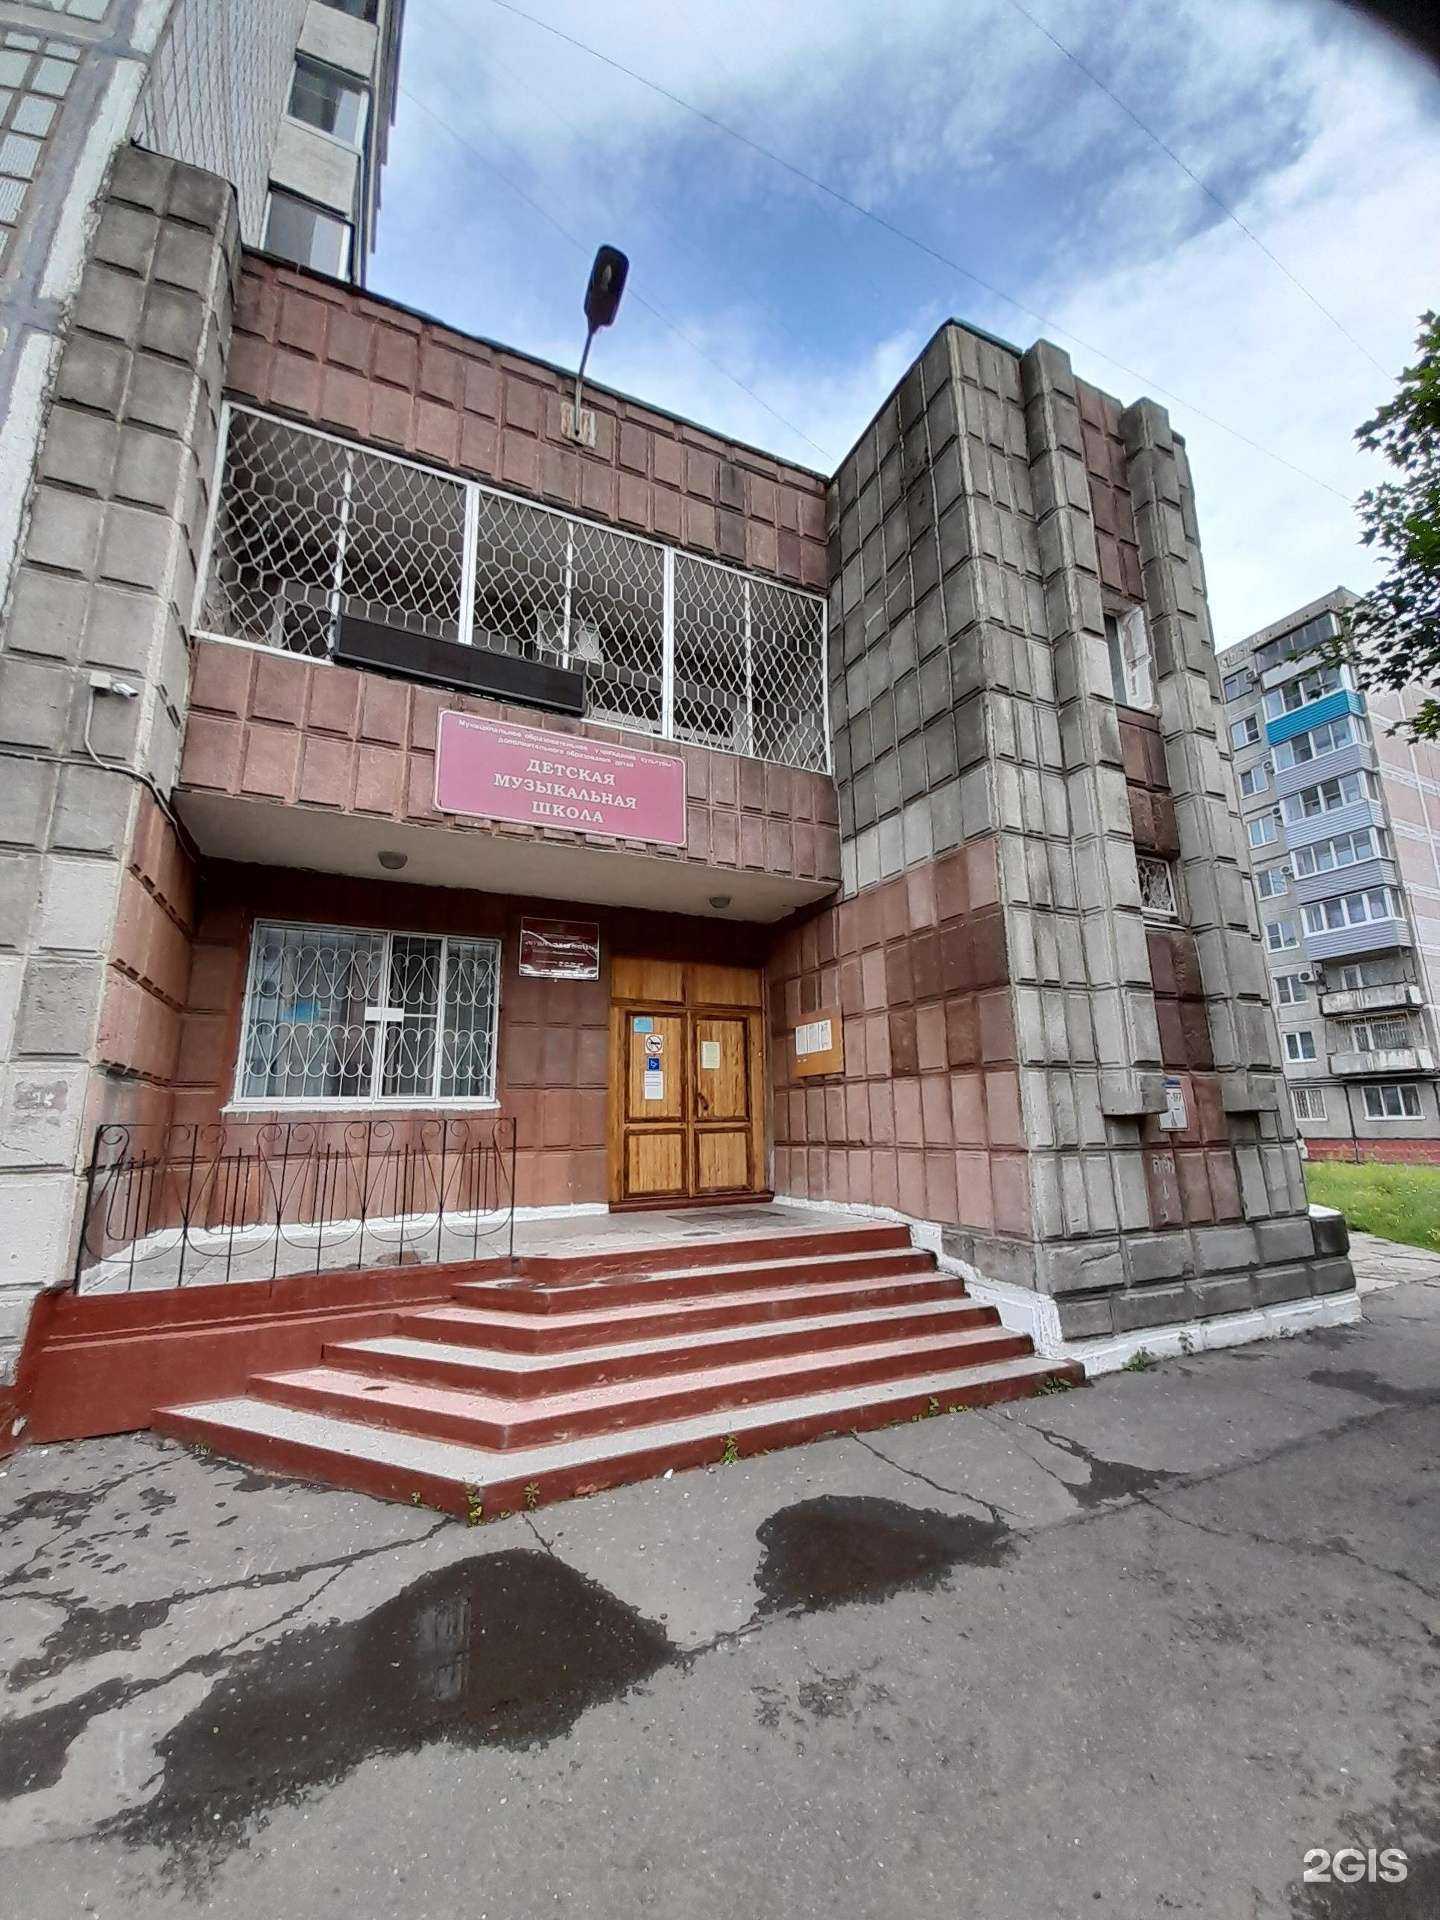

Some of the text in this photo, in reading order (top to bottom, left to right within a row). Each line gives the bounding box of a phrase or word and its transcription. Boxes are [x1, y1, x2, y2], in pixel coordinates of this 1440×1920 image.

[526, 758, 616, 786] ДЕТСКАЯ
[494, 773, 637, 810] МУЗЫКАЛЬНАЯ
[531, 800, 604, 824] ШКОЛА
